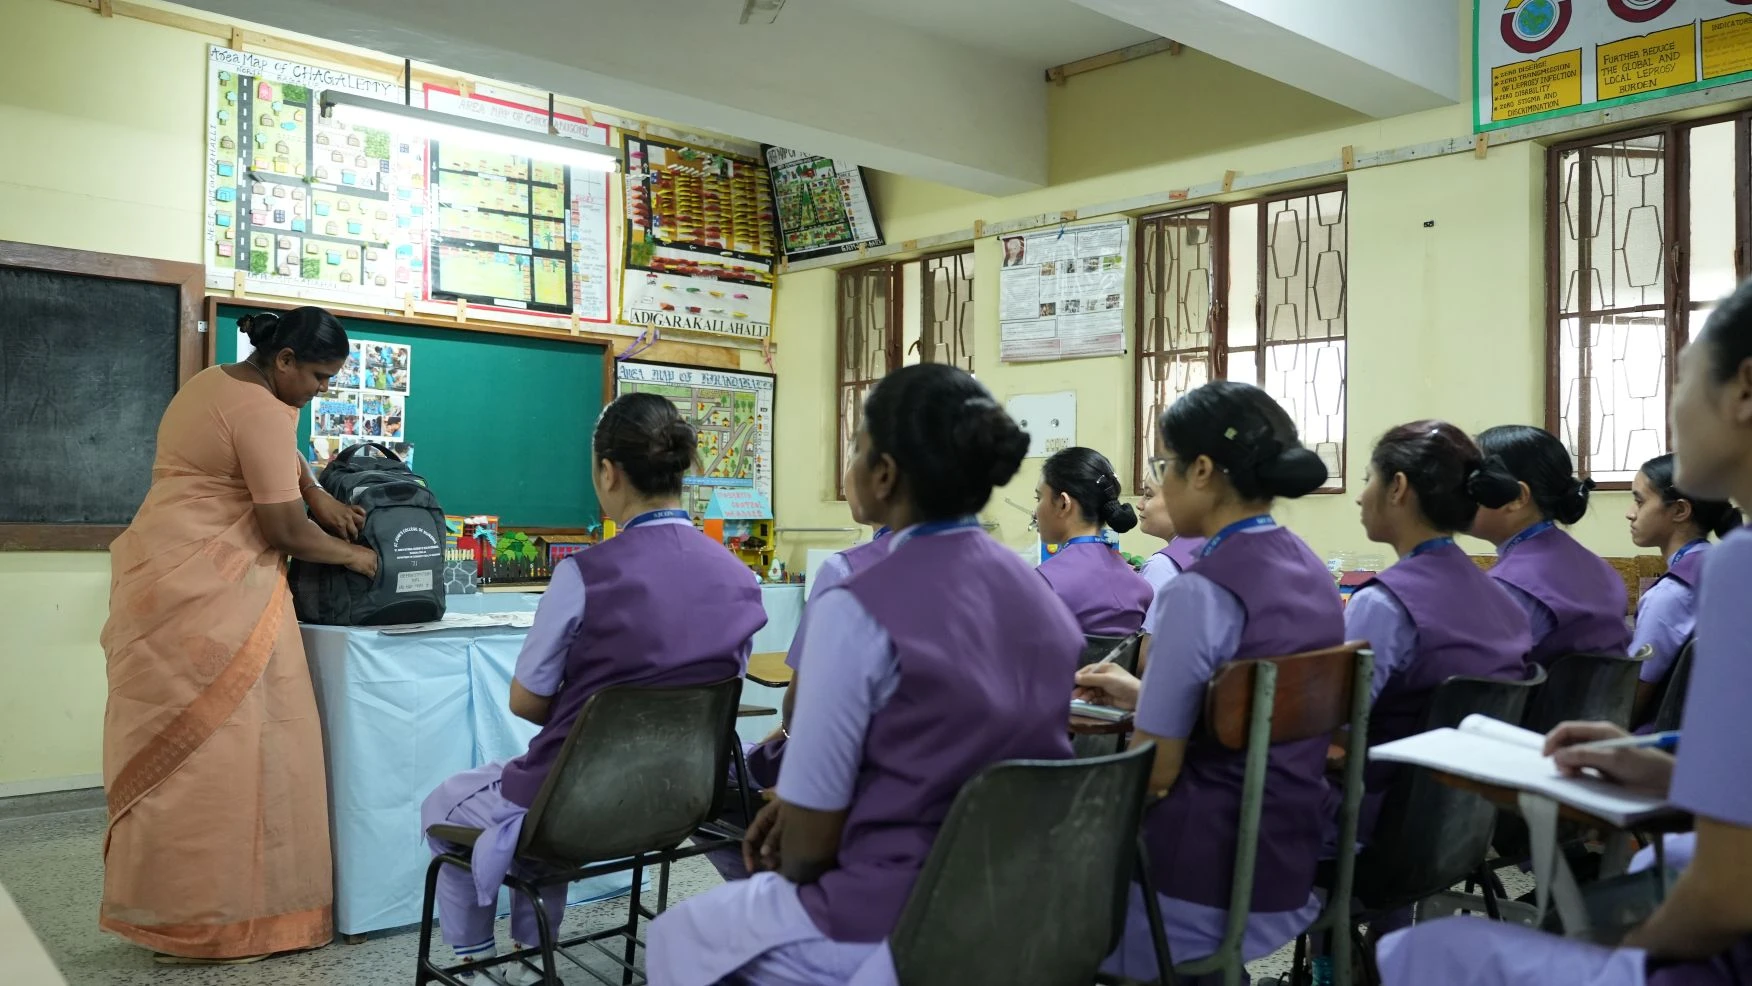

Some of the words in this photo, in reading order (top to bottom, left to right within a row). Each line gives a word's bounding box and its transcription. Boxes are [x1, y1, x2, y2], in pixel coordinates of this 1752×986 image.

[1642, 42, 1675, 57] REDUCE
[1518, 61, 1547, 73] DISEASE
[1601, 65, 1618, 77] THE
[1621, 58, 1653, 72] GLOBAL
[1658, 51, 1681, 64] AND
[243, 53, 268, 71] Map
[292, 65, 392, 96] CHAGALETTY
[1500, 76, 1517, 85] ZERO
[1511, 77, 1540, 91] LEPROSY
[1540, 69, 1577, 84] INFECTION
[1604, 73, 1631, 86] LOCAL
[1637, 62, 1676, 79] LEPROSY
[1499, 93, 1513, 101] ZERO
[1514, 83, 1550, 97] DISABILITY
[1619, 78, 1658, 94] BURDEN
[1499, 101, 1514, 110] ZERO
[1517, 95, 1541, 106] STIGMA
[1543, 92, 1558, 100] AND
[632, 311, 770, 338] ADIGARAKALLAHALLI
[652, 368, 675, 382] MAP
[679, 371, 692, 382] OF
